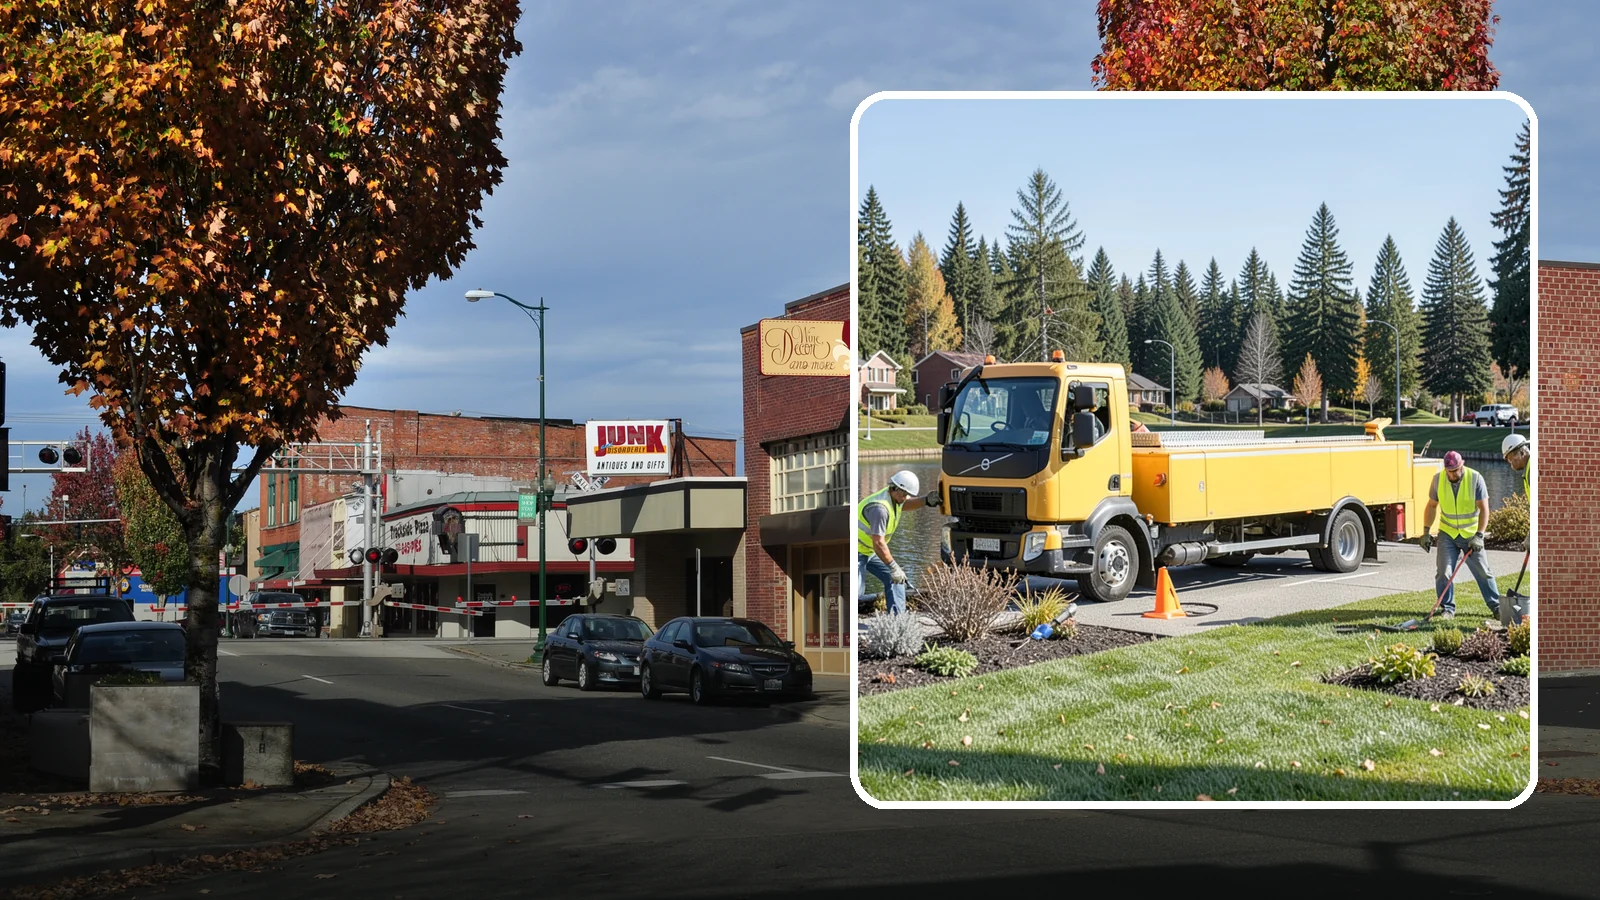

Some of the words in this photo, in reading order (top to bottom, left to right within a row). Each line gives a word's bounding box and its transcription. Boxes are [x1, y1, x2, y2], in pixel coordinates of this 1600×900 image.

[596, 425, 665, 457] JUNK
[607, 446, 646, 454] DISORDERLY
[597, 461, 628, 470] ANTIQUES
[631, 461, 644, 470] AND
[647, 460, 665, 470] GIFTS
[390, 522, 413, 540] Trackside
[414, 519, 429, 535] Pizza
